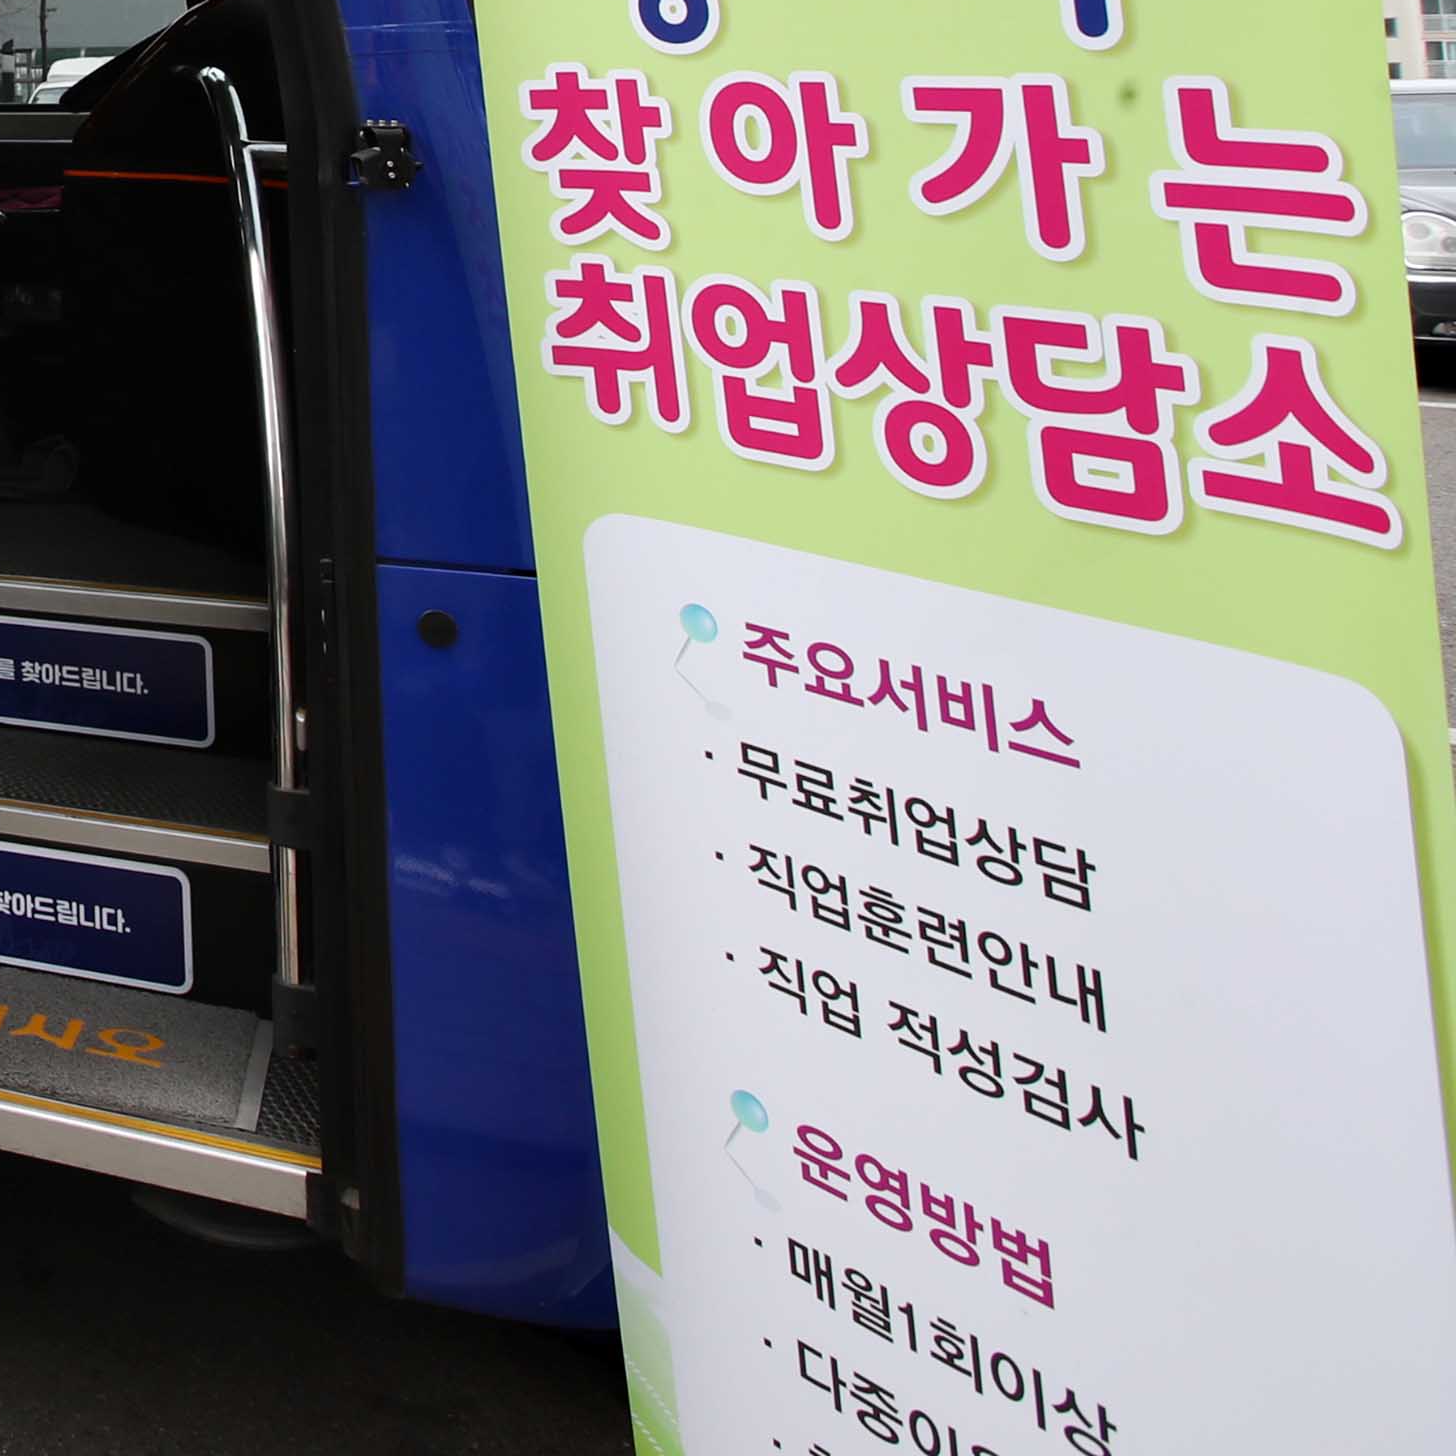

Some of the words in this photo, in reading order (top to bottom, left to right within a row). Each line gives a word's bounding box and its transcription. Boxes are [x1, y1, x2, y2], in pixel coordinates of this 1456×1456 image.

[527, 68, 1360, 306] 찾아가는
[549, 260, 1393, 537] 취업상담소
[20, 660, 150, 695] 찾아드립니다.
[741, 621, 1082, 770] 주요서비스
[736, 741, 1097, 913] 무료취업상담
[747, 843, 1108, 1034] 직업훈련안내
[758, 946, 863, 1040] 직업
[887, 999, 1146, 1162] 적성검사
[791, 1123, 1055, 1308] 운영방법
[796, 1338, 999, 1456] 다중이
